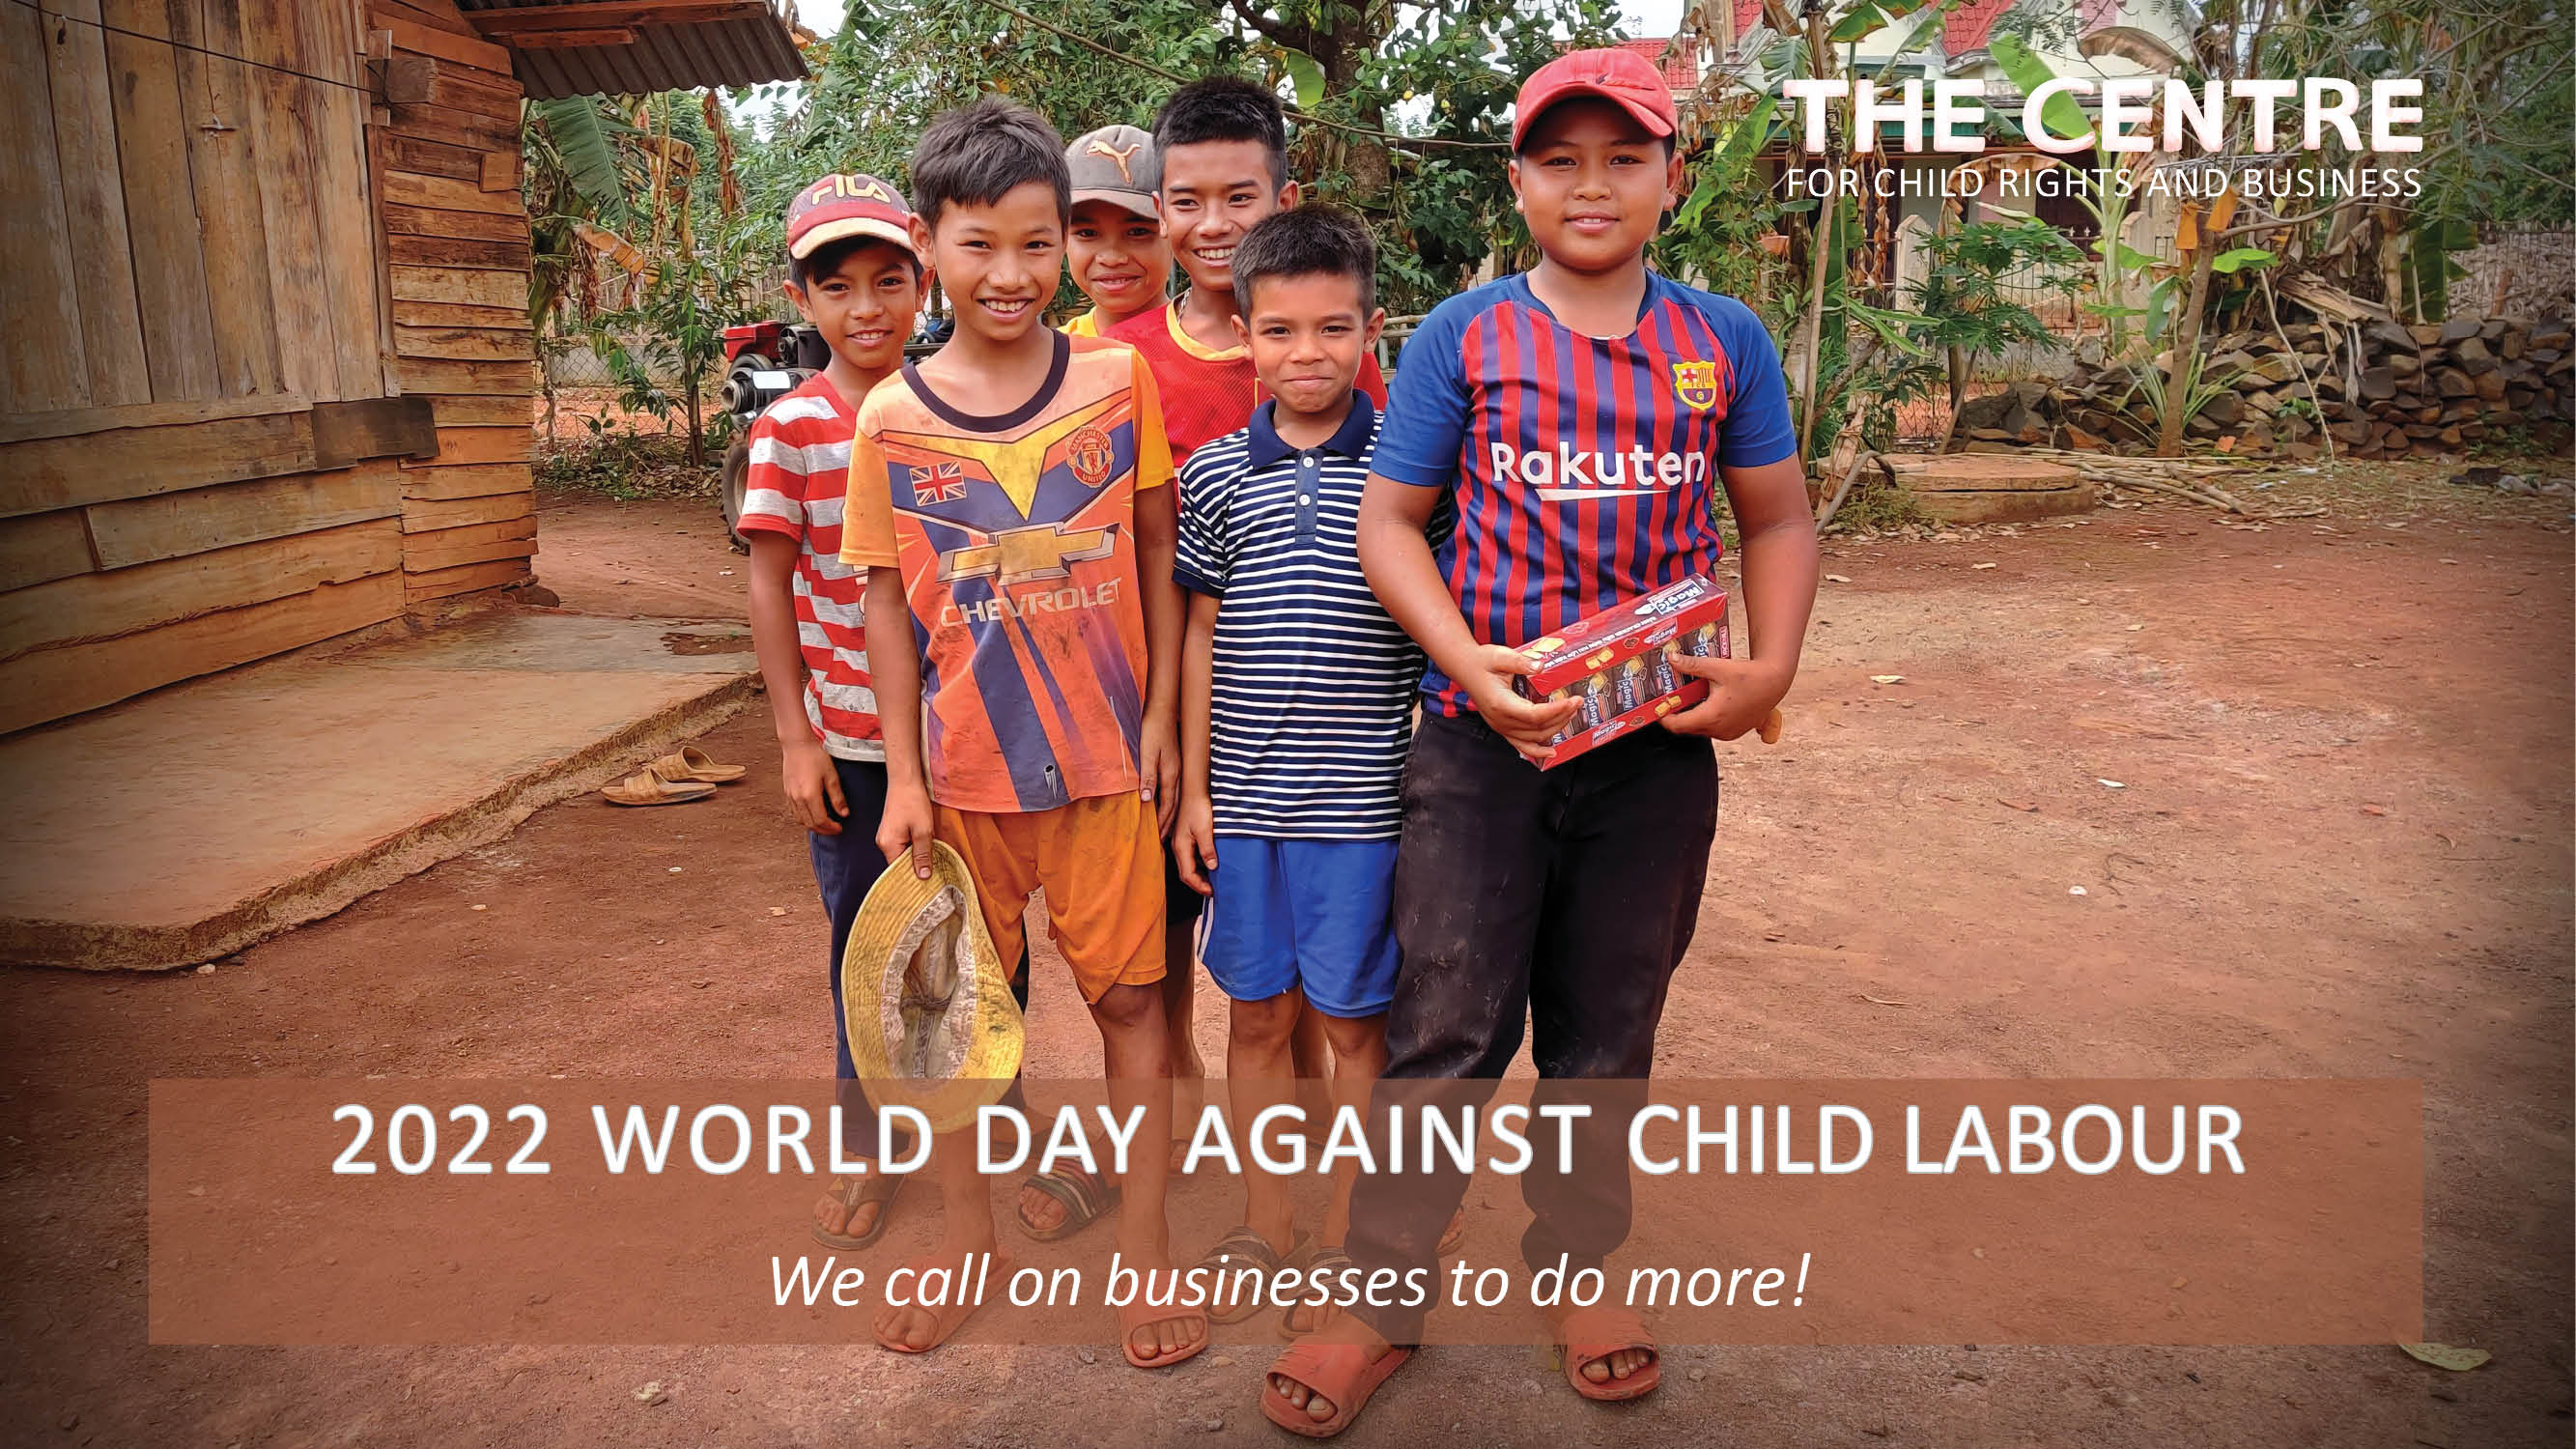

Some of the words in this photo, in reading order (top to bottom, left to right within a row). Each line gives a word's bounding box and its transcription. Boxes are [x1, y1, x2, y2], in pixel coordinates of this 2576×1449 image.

[811, 175, 891, 205] FILA
[1490, 440, 1706, 487] Rakuten
[940, 577, 1121, 627] CHEVROLET
[1656, 585, 1700, 611] Magic
[1622, 679, 1634, 711] Magic
[1587, 696, 1600, 727] Magic
